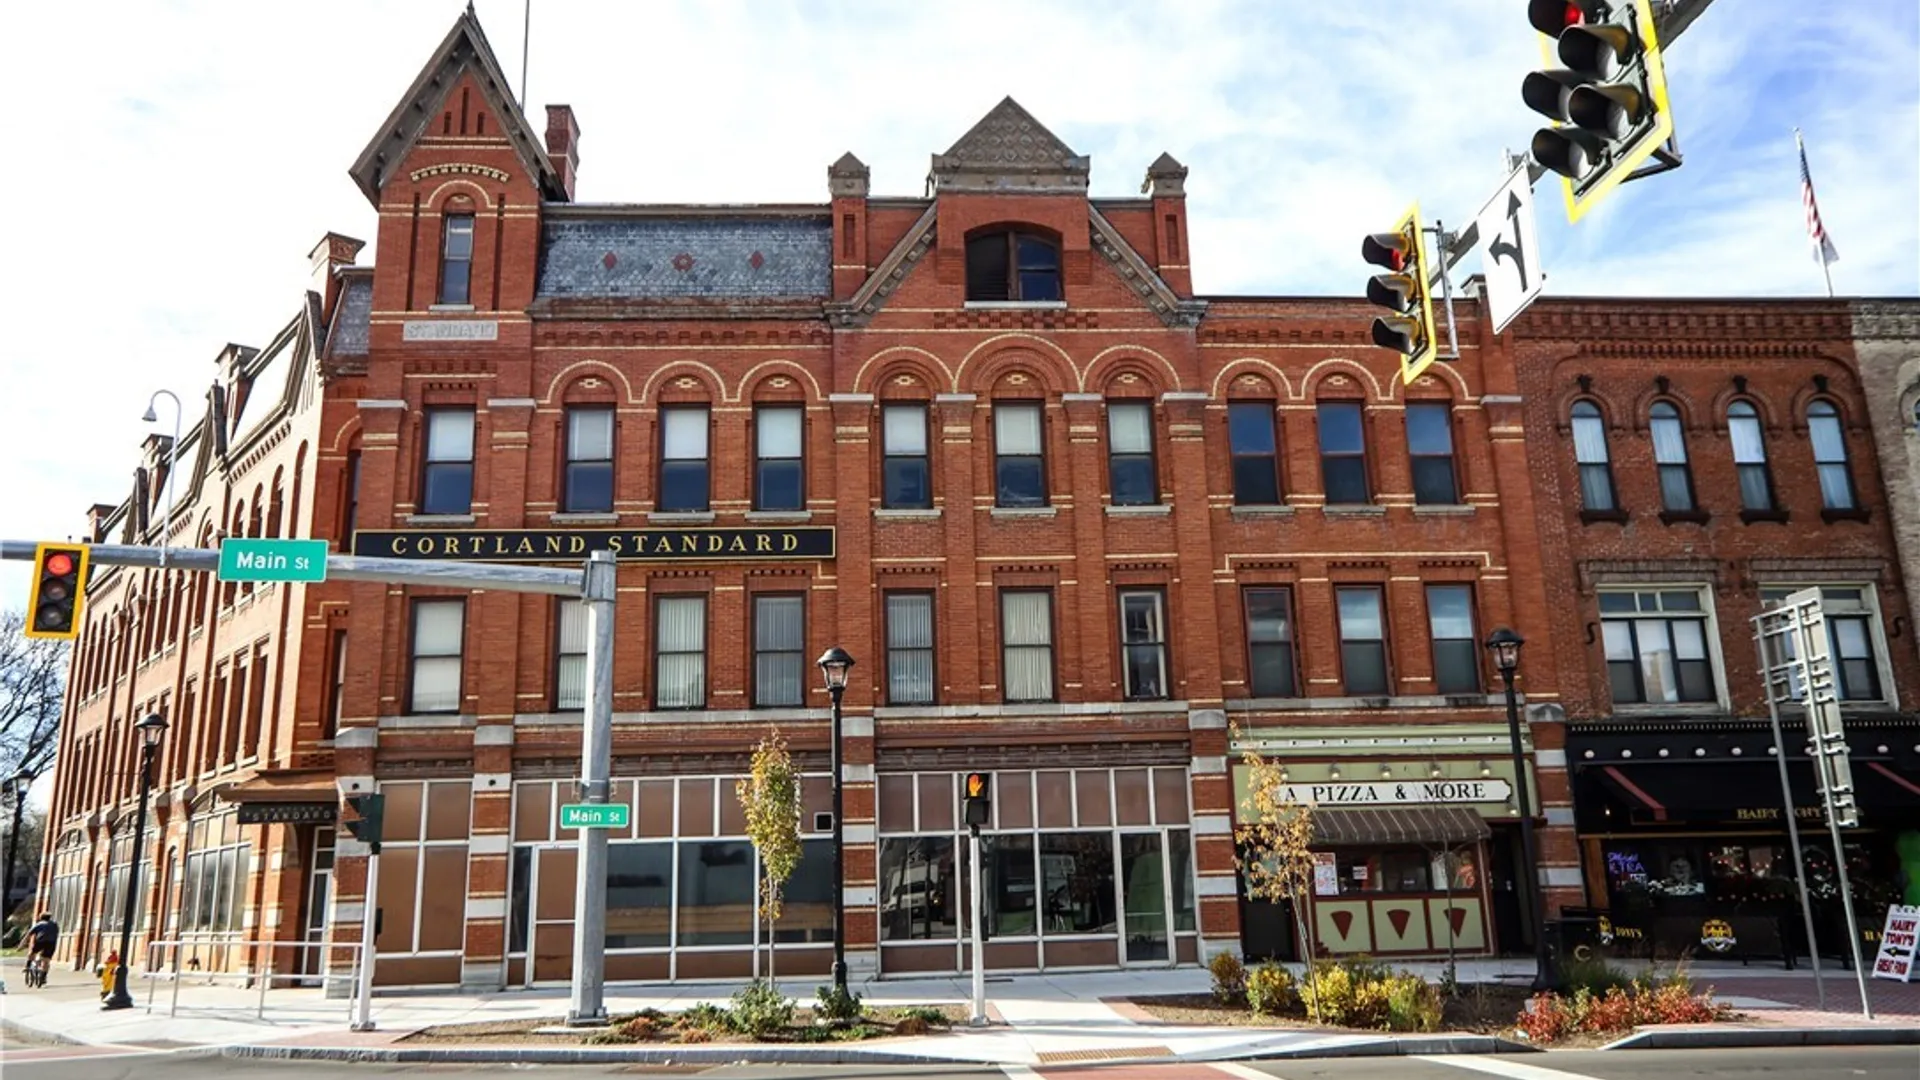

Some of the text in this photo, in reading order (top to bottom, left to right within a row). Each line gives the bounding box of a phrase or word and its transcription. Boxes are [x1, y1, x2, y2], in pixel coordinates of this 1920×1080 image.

[391, 533, 798, 555] CORTLAND STANDARD
[236, 551, 310, 570] Main St
[1312, 785, 1379, 802] PIZZA
[1395, 784, 1407, 800] &
[1423, 782, 1486, 799] MORE
[569, 809, 602, 823] Main
[1736, 807, 1780, 820] HAIRY
[1890, 919, 1917, 932] HAIRY
